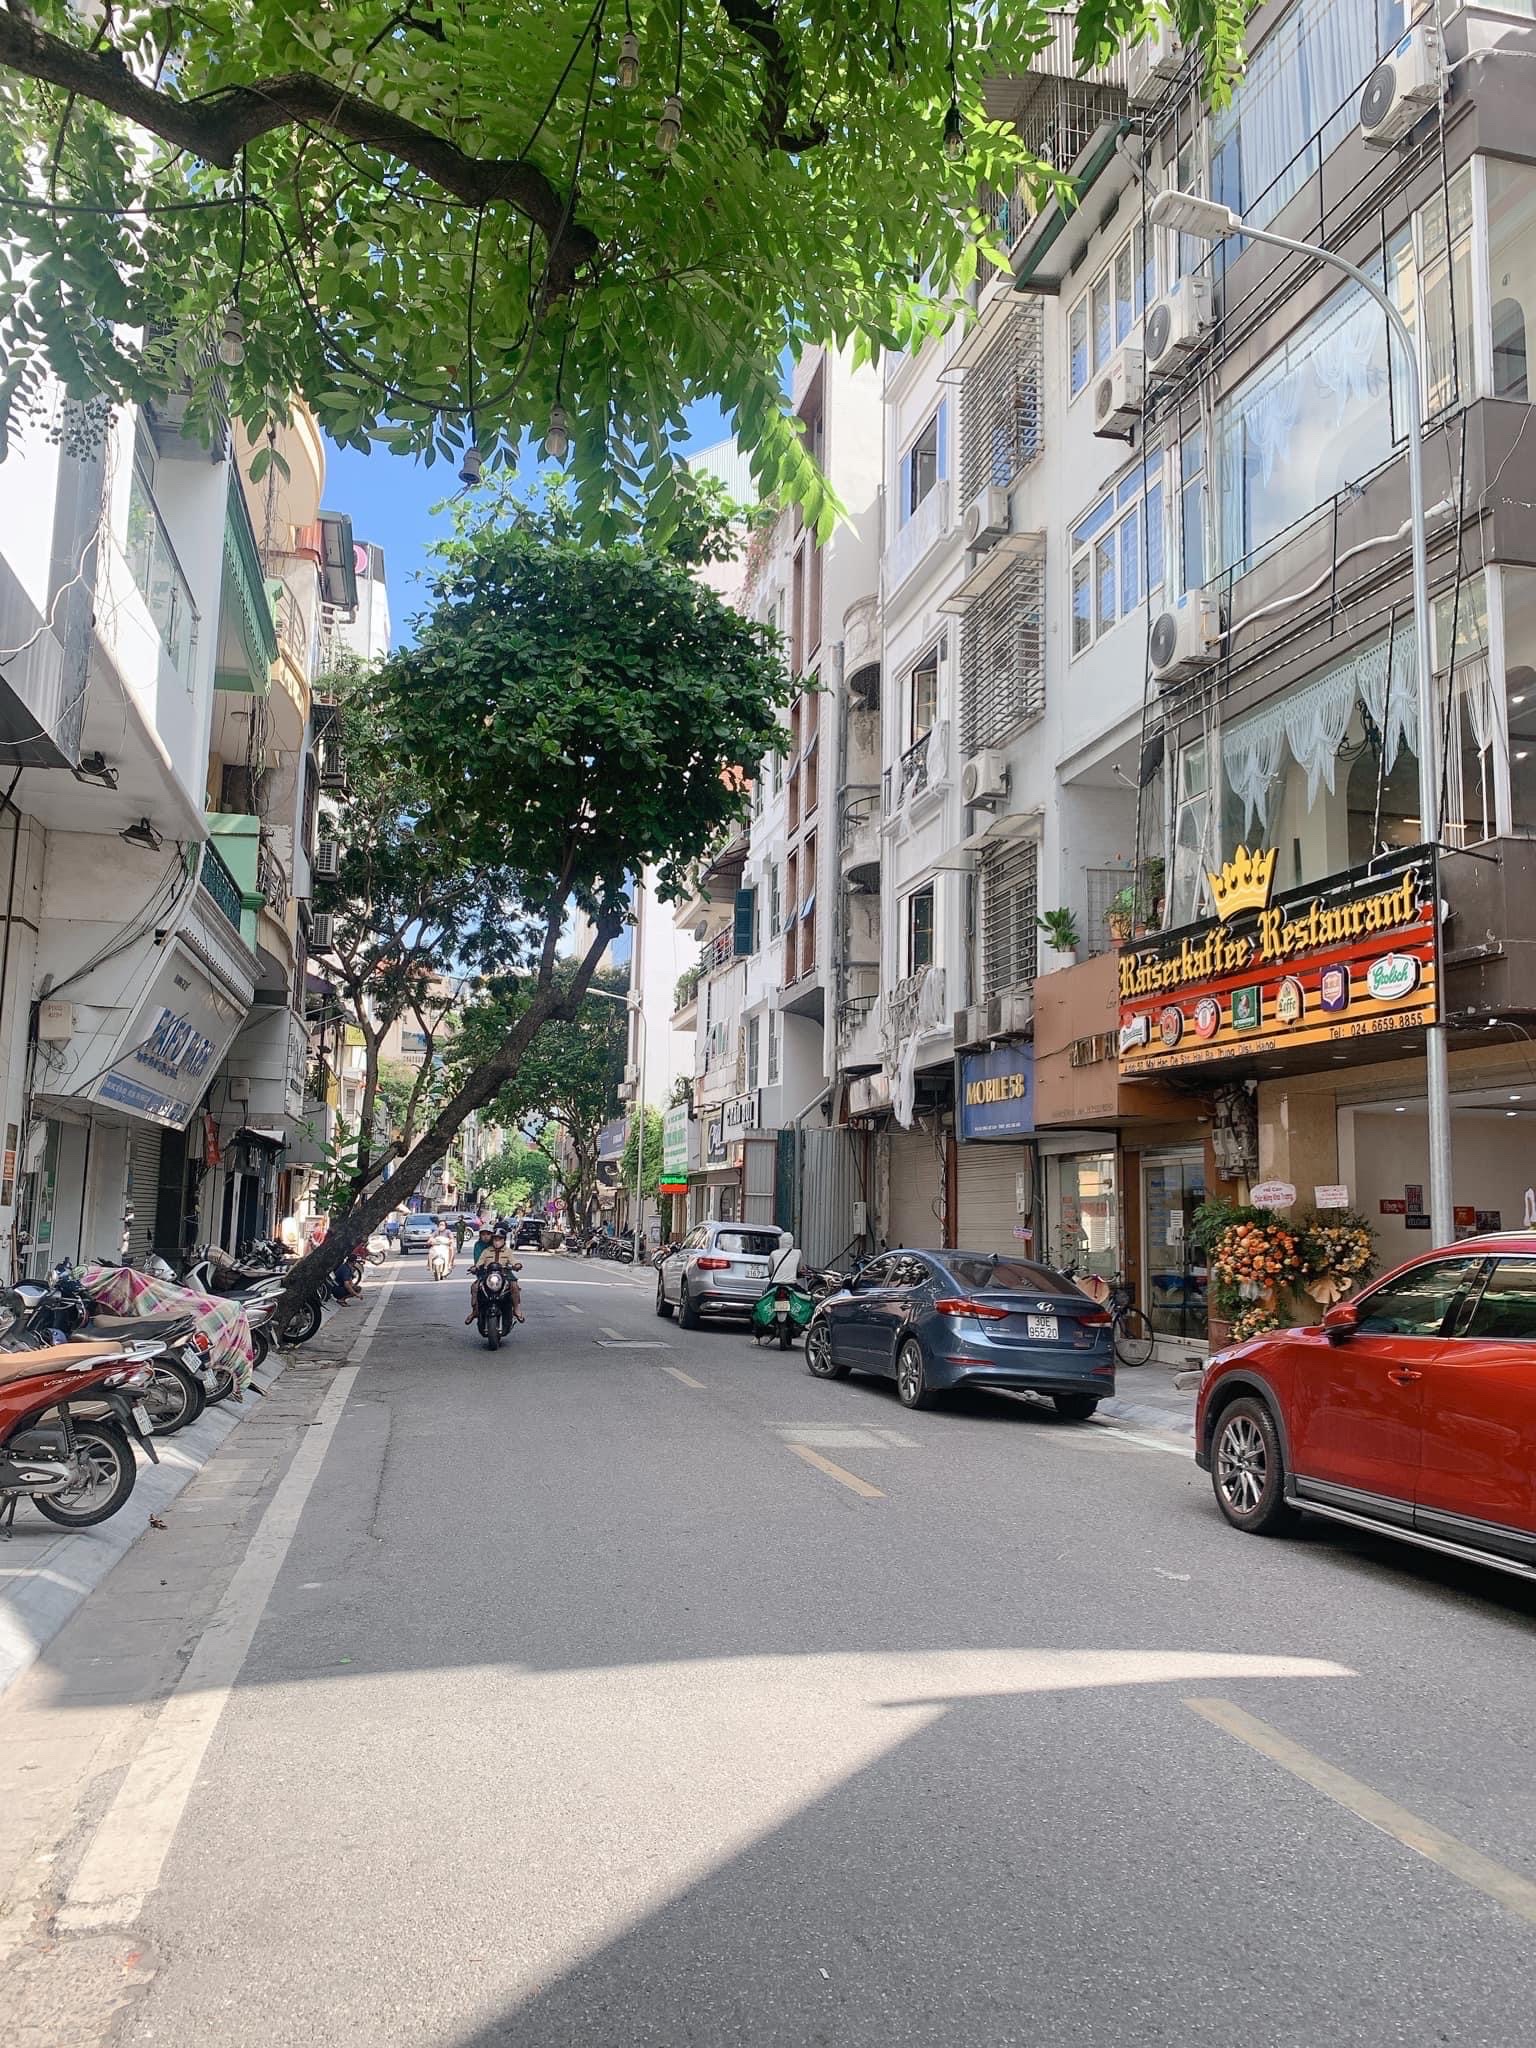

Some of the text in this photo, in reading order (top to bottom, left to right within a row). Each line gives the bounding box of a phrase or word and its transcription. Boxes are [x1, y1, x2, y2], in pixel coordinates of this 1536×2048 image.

[1257, 868, 1417, 962] Restaurant
[1372, 962, 1409, 990] Grolsch
[1329, 1027, 1345, 1039] Tel:
[1035, 1316, 1051, 1327] 30E
